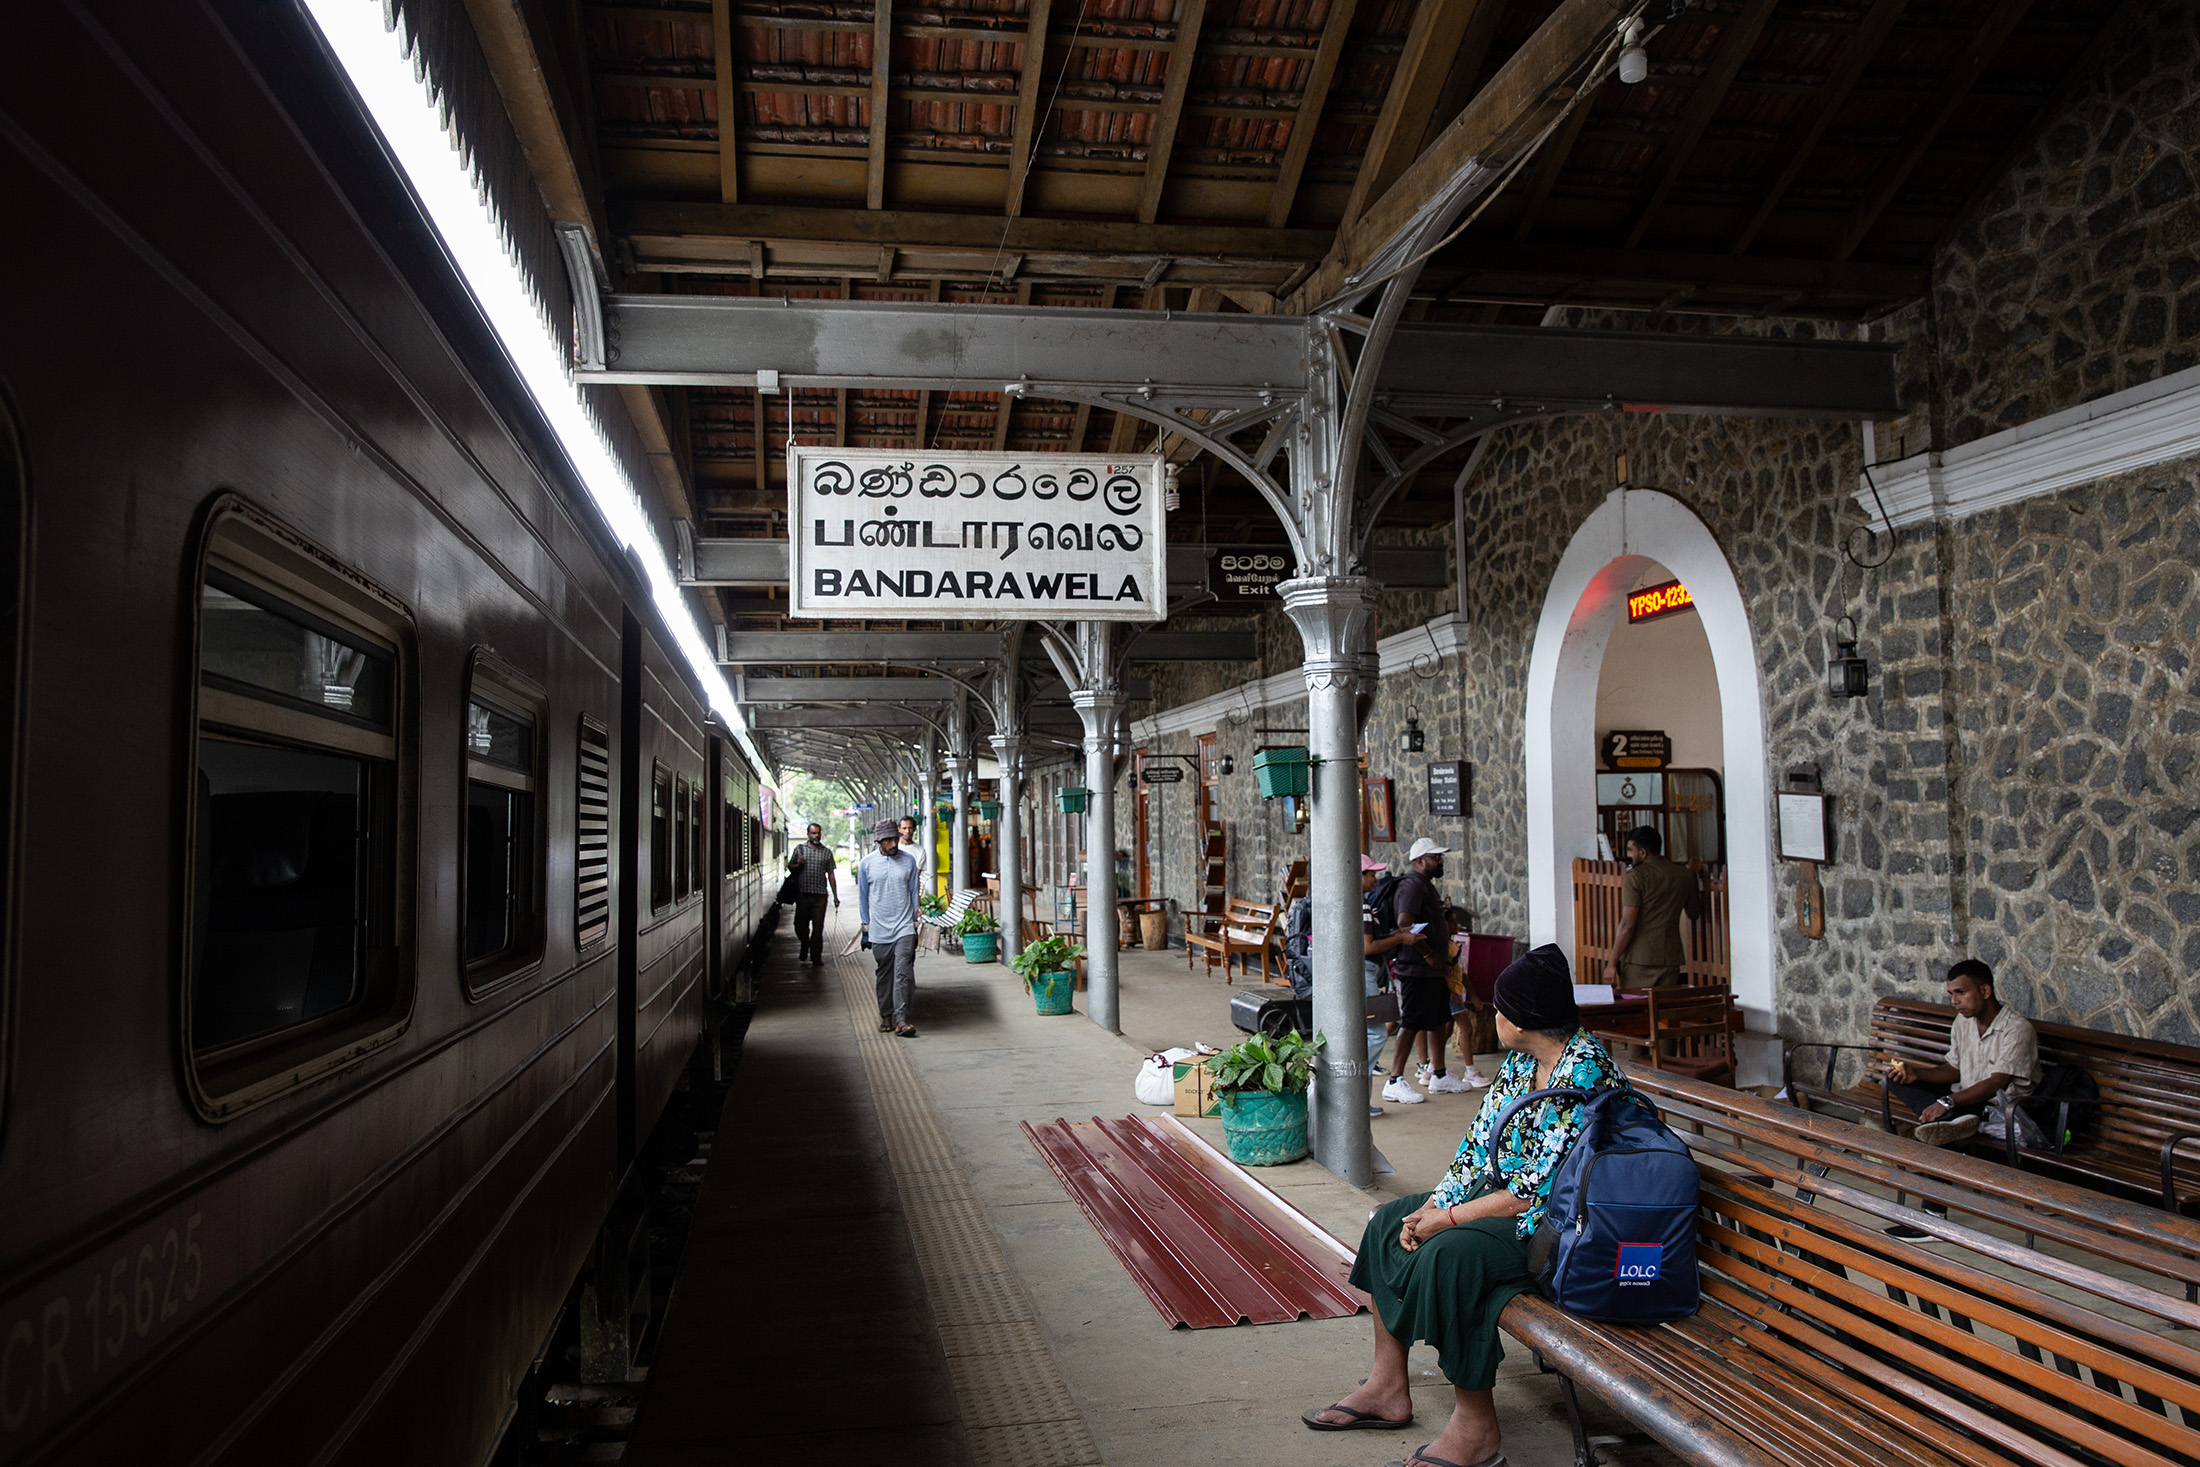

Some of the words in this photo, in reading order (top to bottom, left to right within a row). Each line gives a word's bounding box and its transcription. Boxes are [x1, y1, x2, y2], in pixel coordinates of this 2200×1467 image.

[1113, 465, 1135, 474] 257
[813, 461, 1142, 516] බණ්ඩාරවෙල
[814, 505, 1144, 561] பண்டாரவெல
[1220, 554, 1286, 571] පිටවීම
[814, 568, 1144, 602] BANDARAWELA
[1238, 585, 1270, 595] Exit
[1612, 734, 1628, 757] 2
[1620, 1265, 1657, 1278] LOLC
[2, 1295, 73, 1432] CR
[84, 1211, 202, 1374] 15625
